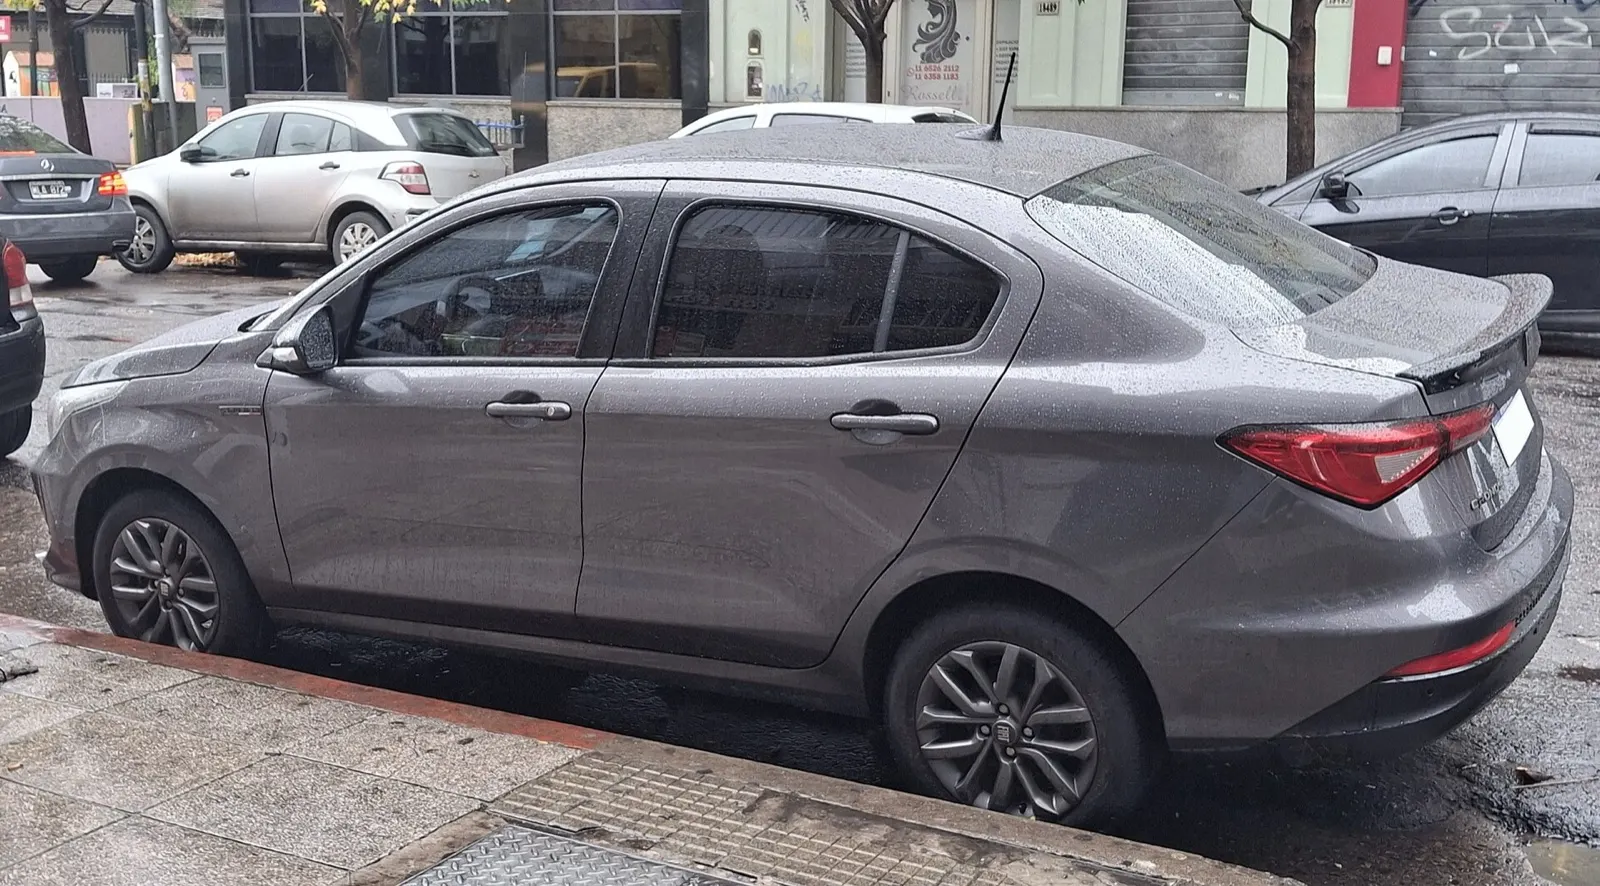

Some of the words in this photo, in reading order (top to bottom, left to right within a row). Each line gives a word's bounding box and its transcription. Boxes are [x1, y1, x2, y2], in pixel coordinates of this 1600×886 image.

[915, 64, 922, 72] 11
[924, 64, 942, 72] 6526
[943, 64, 959, 72] 2112
